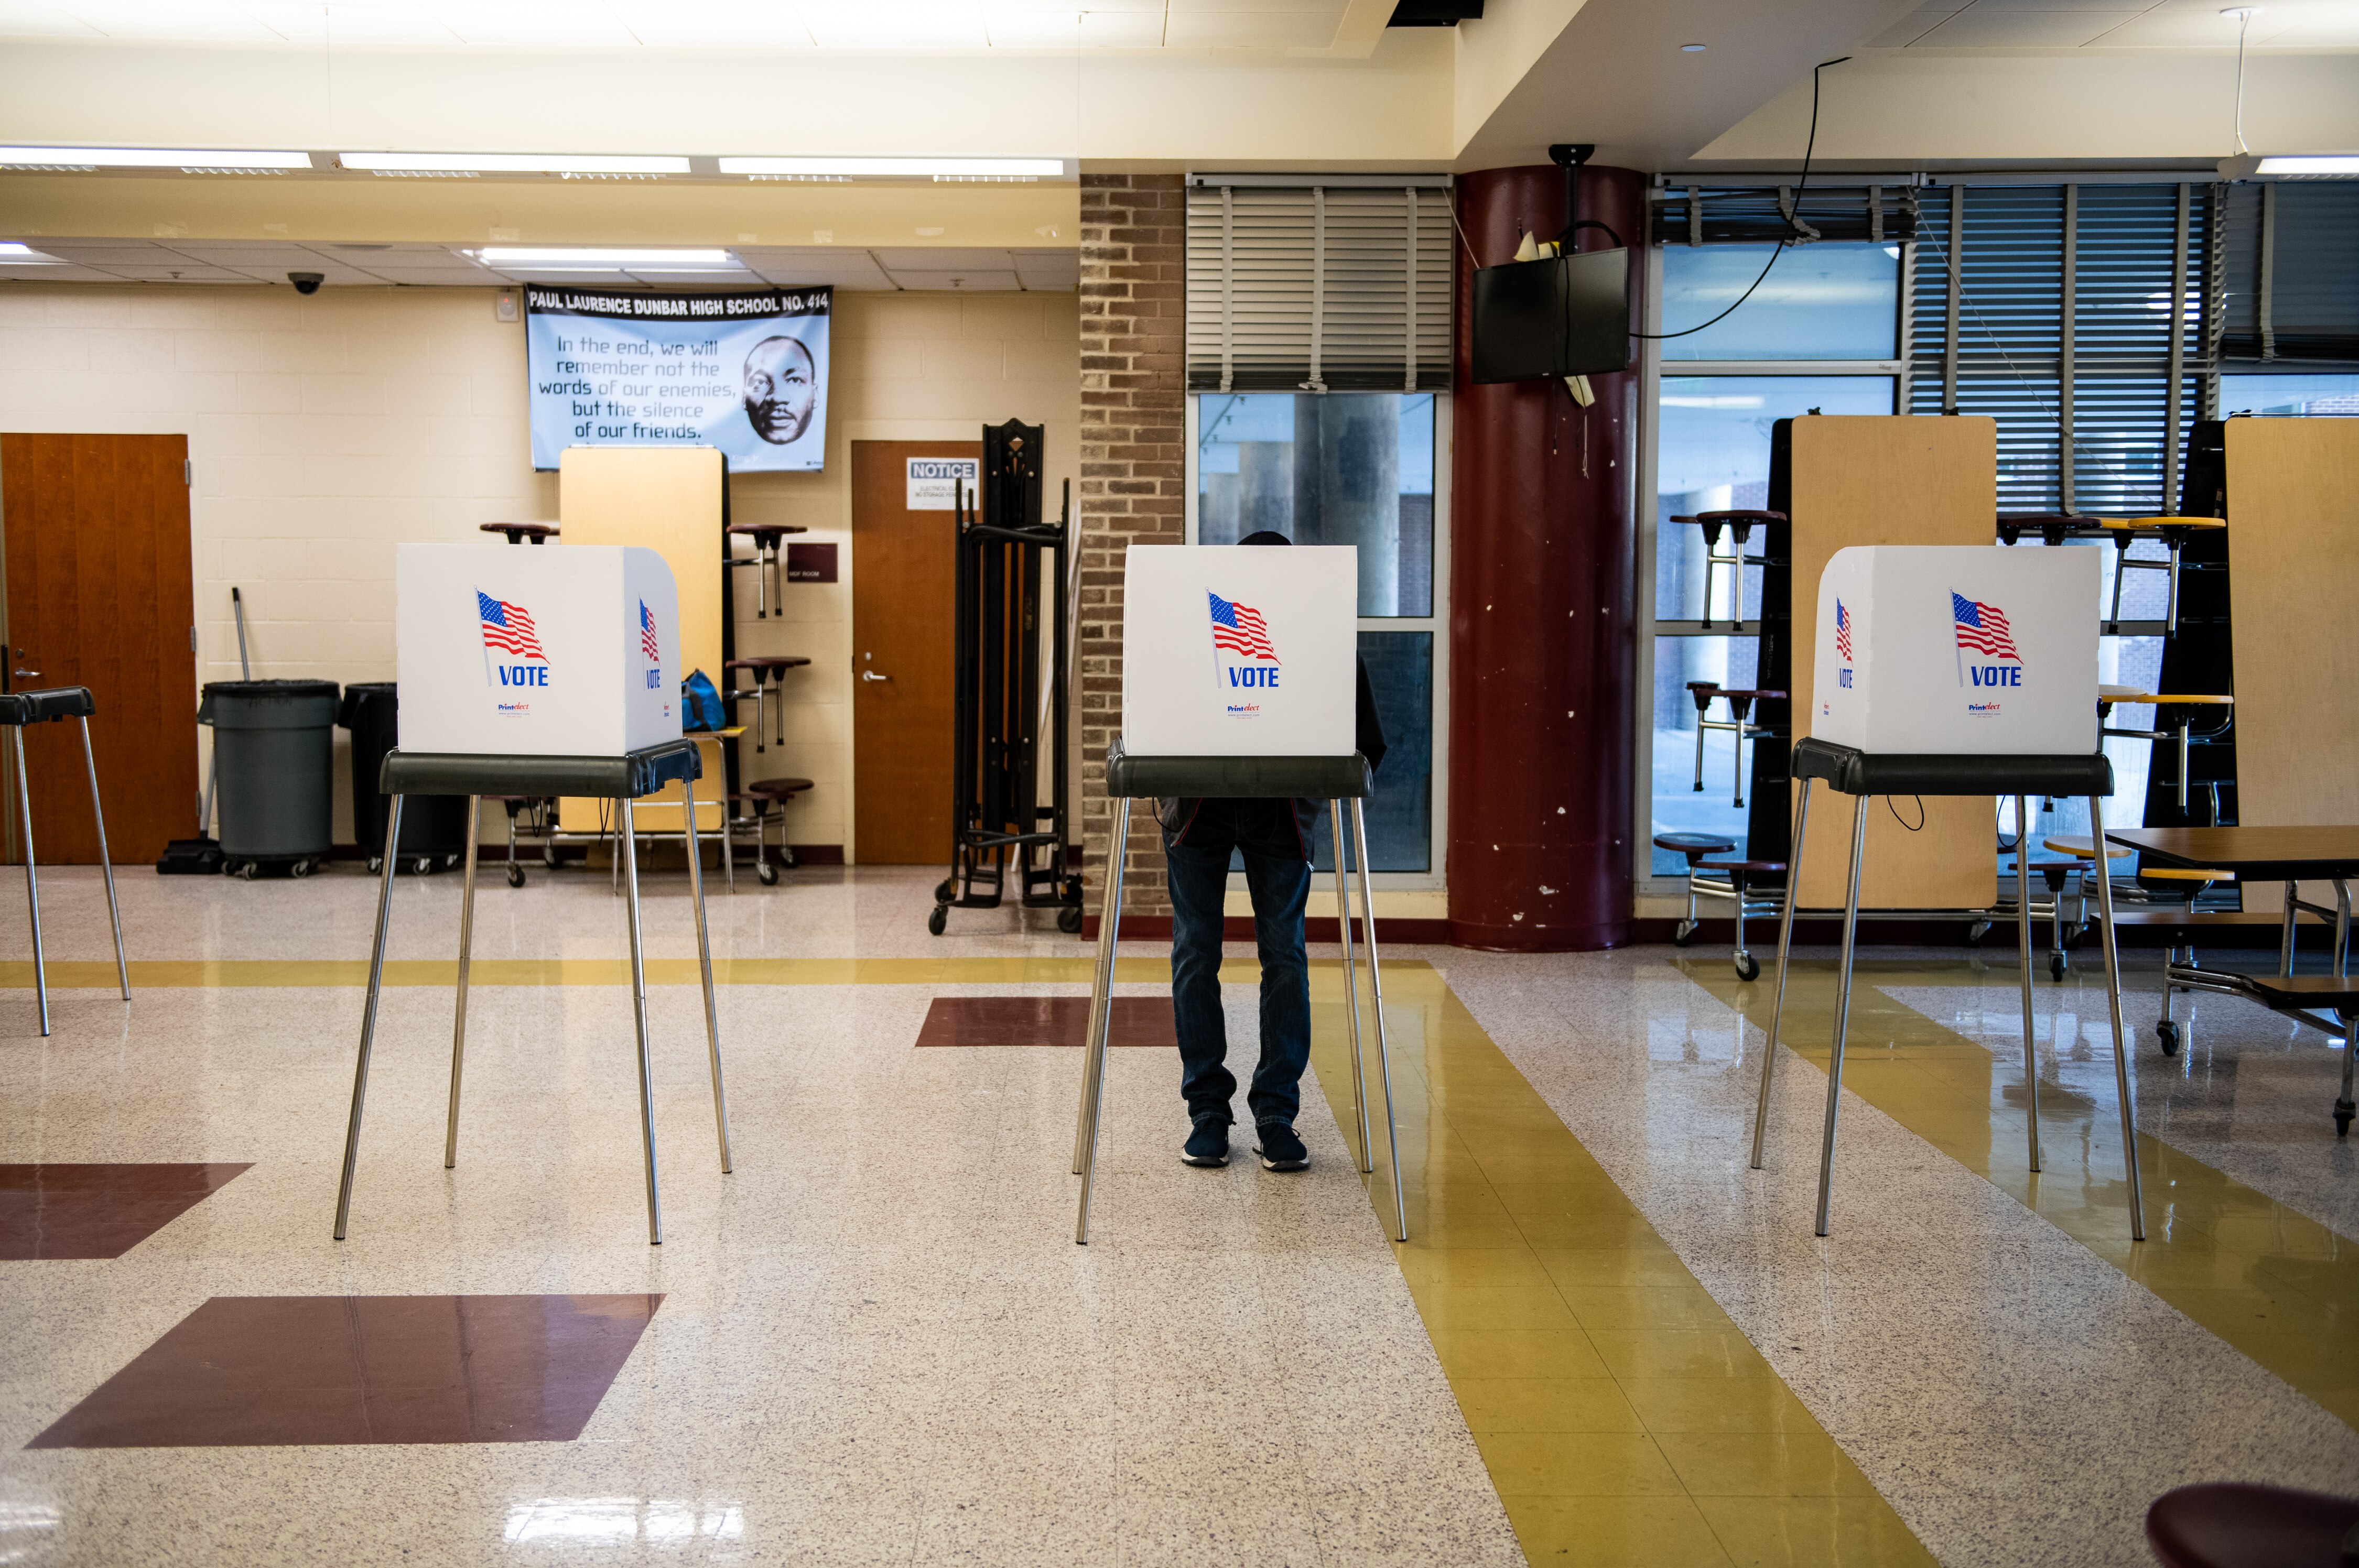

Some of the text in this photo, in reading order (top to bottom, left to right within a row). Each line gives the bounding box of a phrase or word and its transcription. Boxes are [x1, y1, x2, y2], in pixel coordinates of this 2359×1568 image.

[530, 291, 828, 316] PAUL LAURENCE DUNBAR HIGH SCHOOL NO. 414
[558, 335, 718, 357] In the end, we will
[557, 360, 719, 376] remember not the
[539, 378, 736, 398] words of our enemies,
[573, 400, 703, 417] but the silence
[575, 421, 701, 438] of our friends.
[914, 463, 973, 477] NOTICE
[499, 666, 548, 687] VOTE
[646, 669, 661, 690] VOTE
[1229, 667, 1279, 687] VOTE
[1839, 668, 1853, 689] VOTE
[1971, 666, 2021, 687] VOTE
